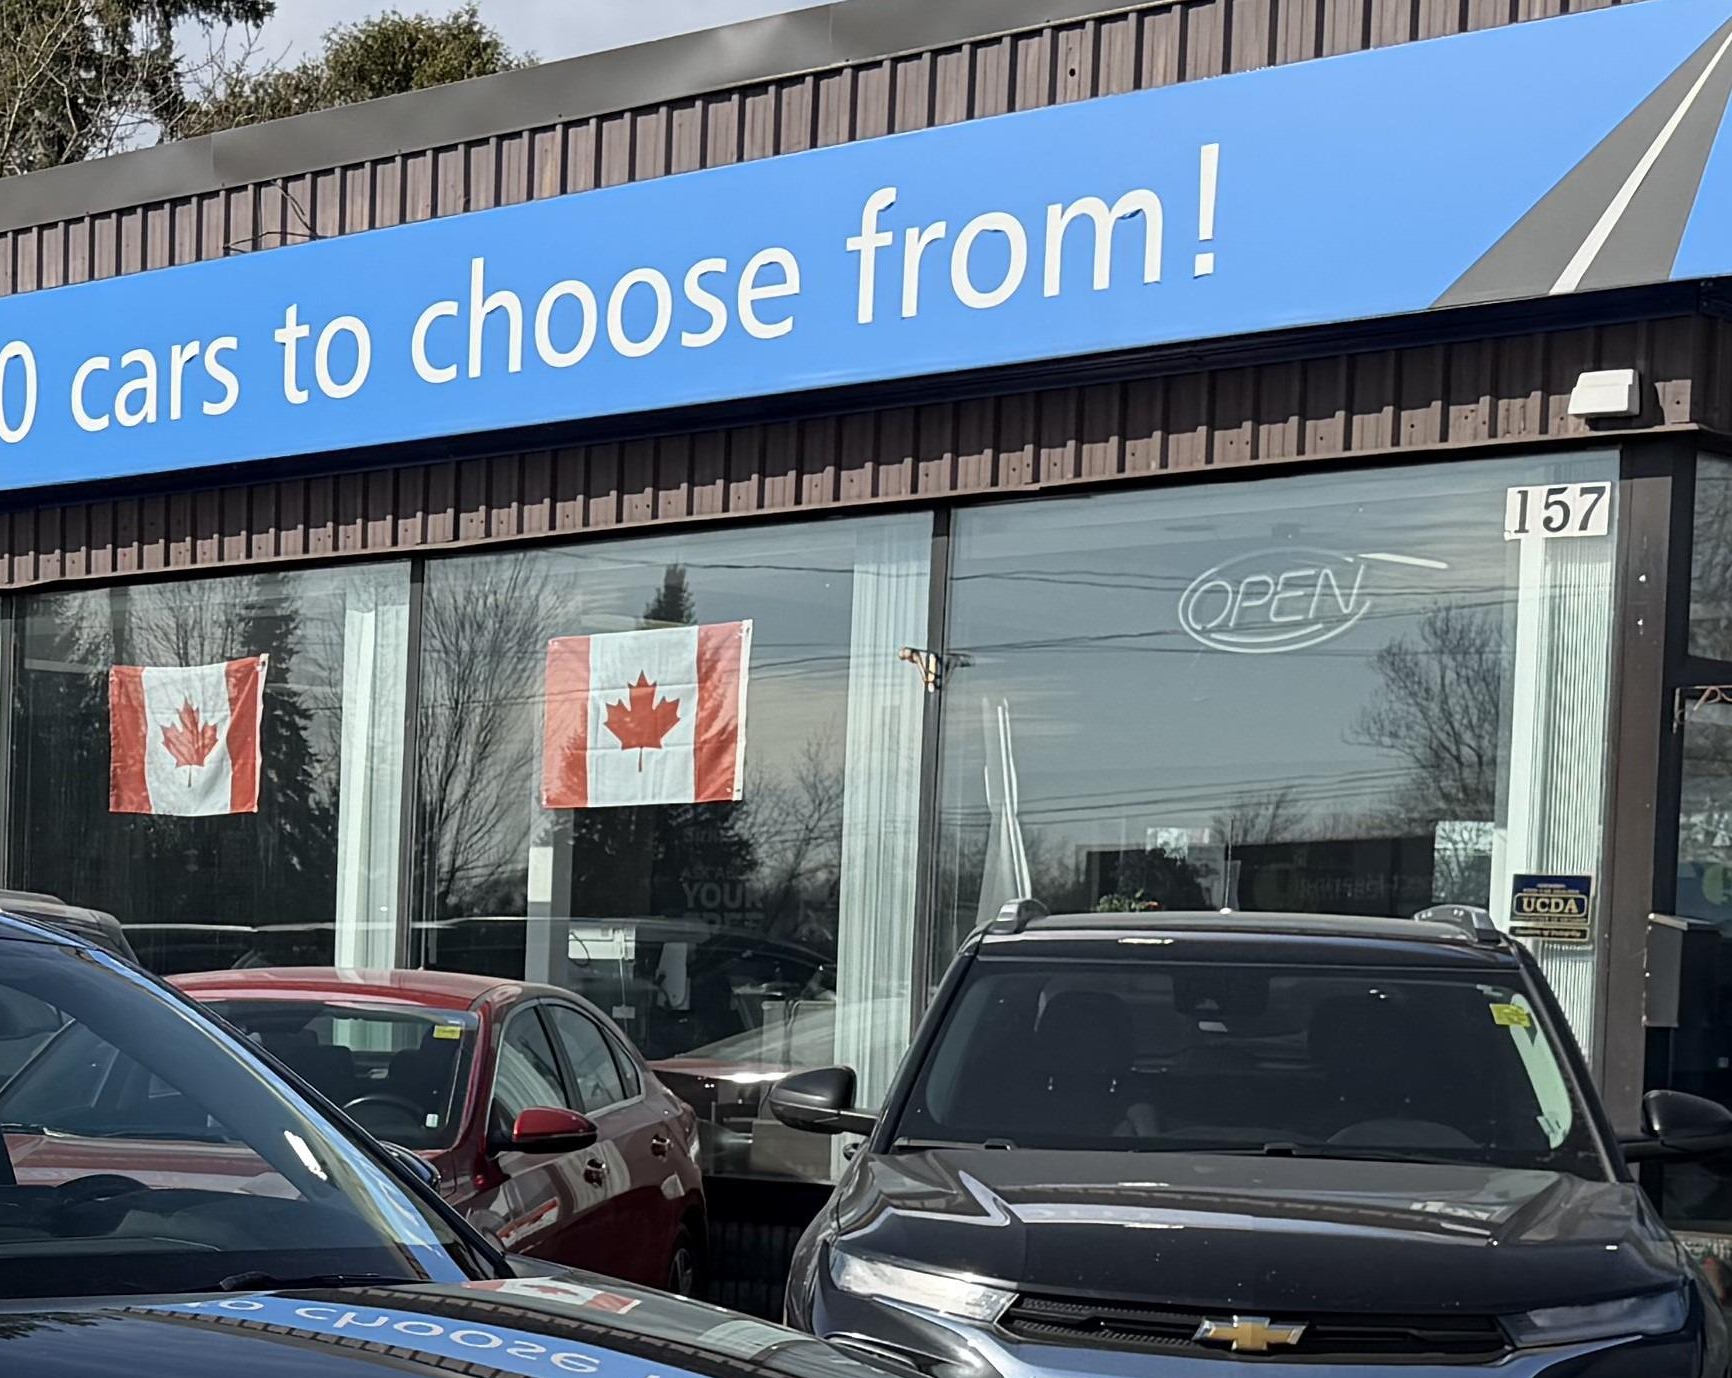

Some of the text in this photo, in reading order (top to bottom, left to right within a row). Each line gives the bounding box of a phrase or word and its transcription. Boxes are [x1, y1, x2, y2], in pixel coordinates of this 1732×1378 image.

[71, 336, 240, 433] cars
[274, 303, 372, 405] to
[411, 257, 800, 385] choose
[847, 143, 1220, 325] from!
[1513, 486, 1606, 534] 157
[1188, 563, 1365, 631] OPEN
[681, 882, 764, 909] YOUR
[1521, 896, 1580, 914] UCDA
